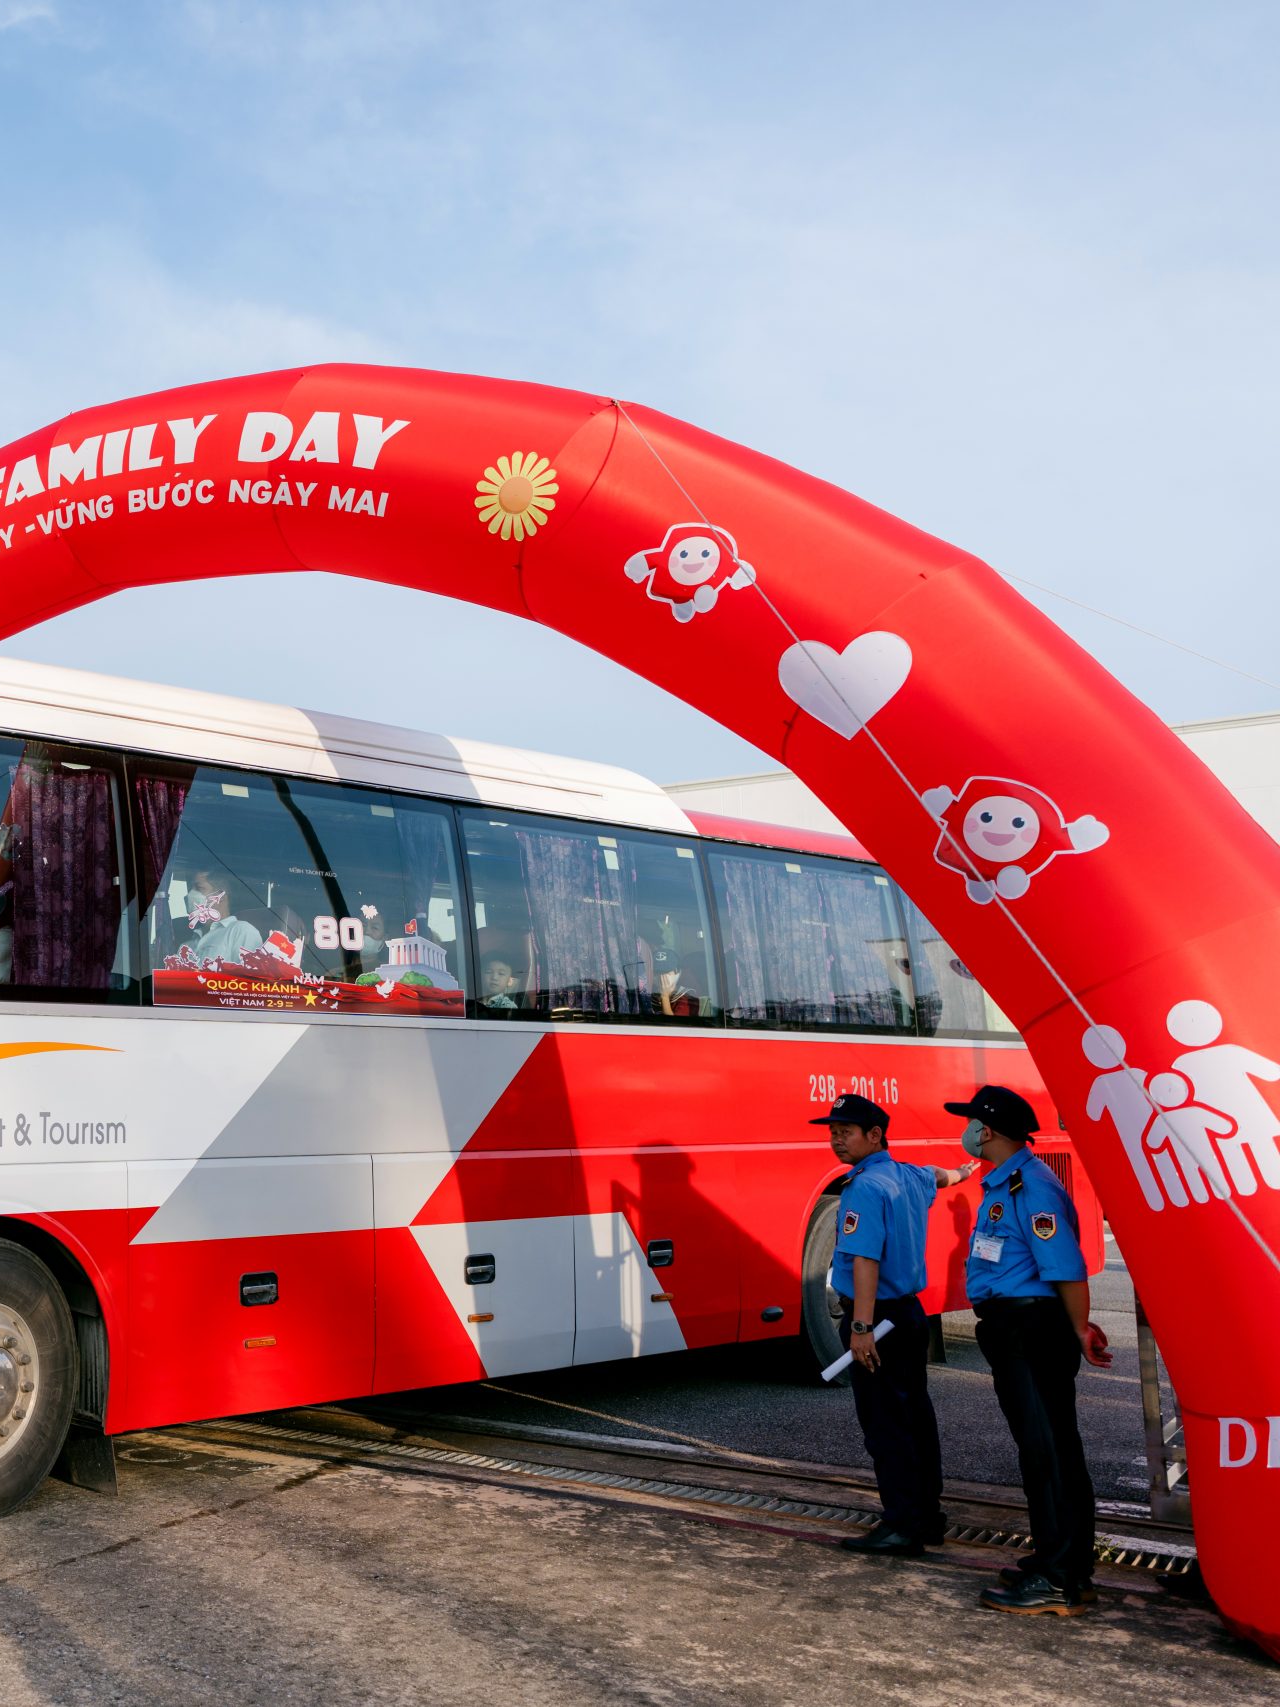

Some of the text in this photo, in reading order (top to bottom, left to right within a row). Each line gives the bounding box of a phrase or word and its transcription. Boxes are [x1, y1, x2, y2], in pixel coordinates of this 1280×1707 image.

[238, 412, 410, 469] DAY
[128, 472, 215, 513] BƯỚC
[228, 475, 318, 507] NGÀY
[328, 486, 389, 517] MAI
[314, 916, 364, 951] 80
[206, 978, 300, 994] QUỐC KHÁNH
[294, 973, 324, 985] NĂM
[219, 997, 240, 1007] VIỆT
[242, 999, 265, 1007] NAM
[267, 999, 284, 1008] 2-9
[809, 1074, 836, 1102] 29B
[851, 1075, 899, 1105] 201.16
[13, 1113, 32, 1146] &
[39, 1111, 127, 1145] Tourism
